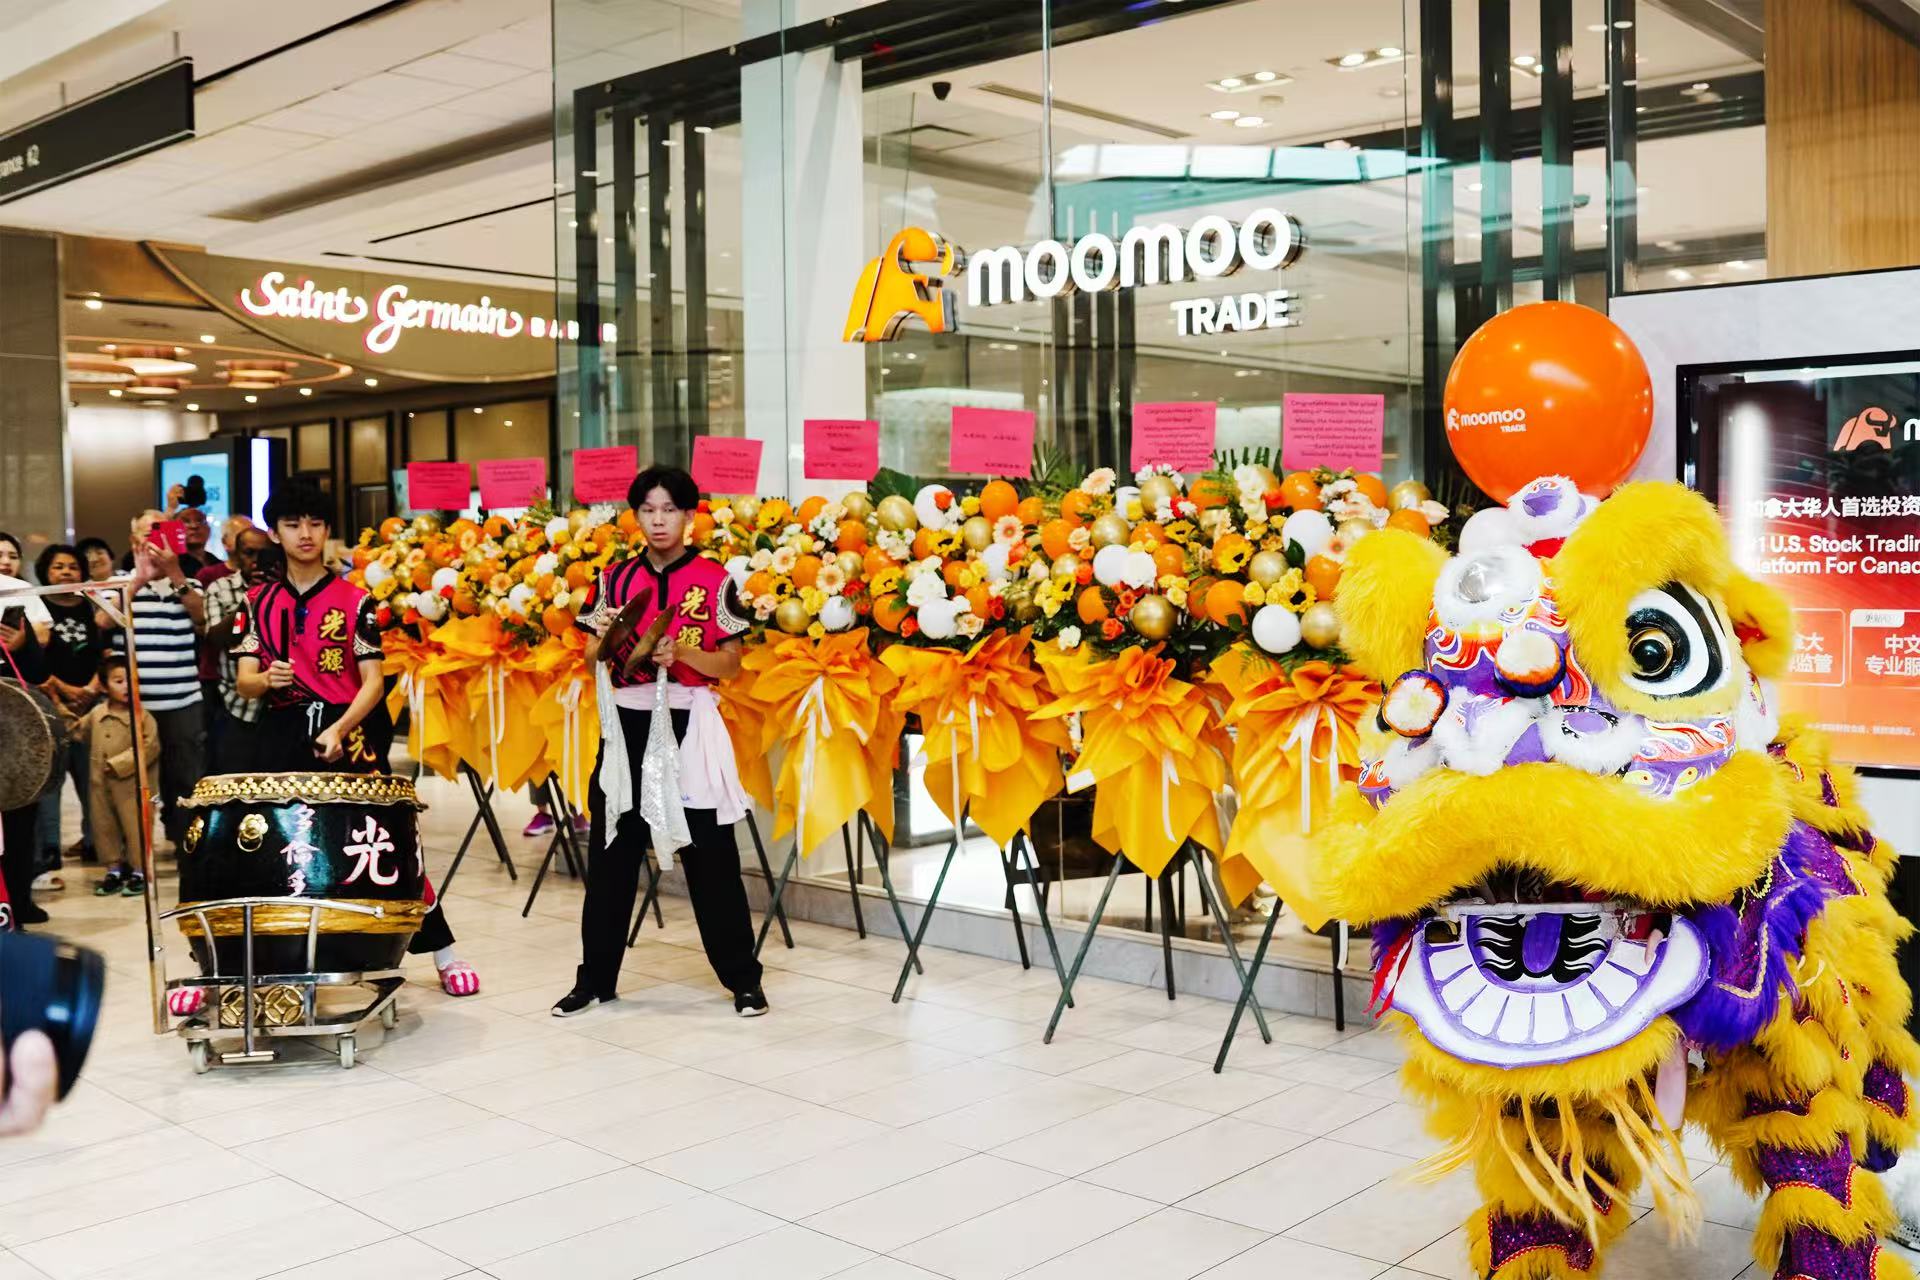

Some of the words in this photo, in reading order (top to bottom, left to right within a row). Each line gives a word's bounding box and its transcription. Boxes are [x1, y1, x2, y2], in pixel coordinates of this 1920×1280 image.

[967, 207, 1296, 306] moomoo
[240, 271, 368, 323] Saint
[365, 284, 523, 354] Germain
[530, 316, 618, 342] BAKR
[1170, 290, 1290, 336] TRADE
[1460, 408, 1526, 427] moomoo
[1500, 423, 1527, 433] TRADE
[1770, 536, 1805, 552] U.S.
[1809, 535, 1863, 552] Stock
[1756, 556, 1821, 574] atform
[1825, 557, 1857, 574] For
[1884, 634, 1920, 654] 中文
